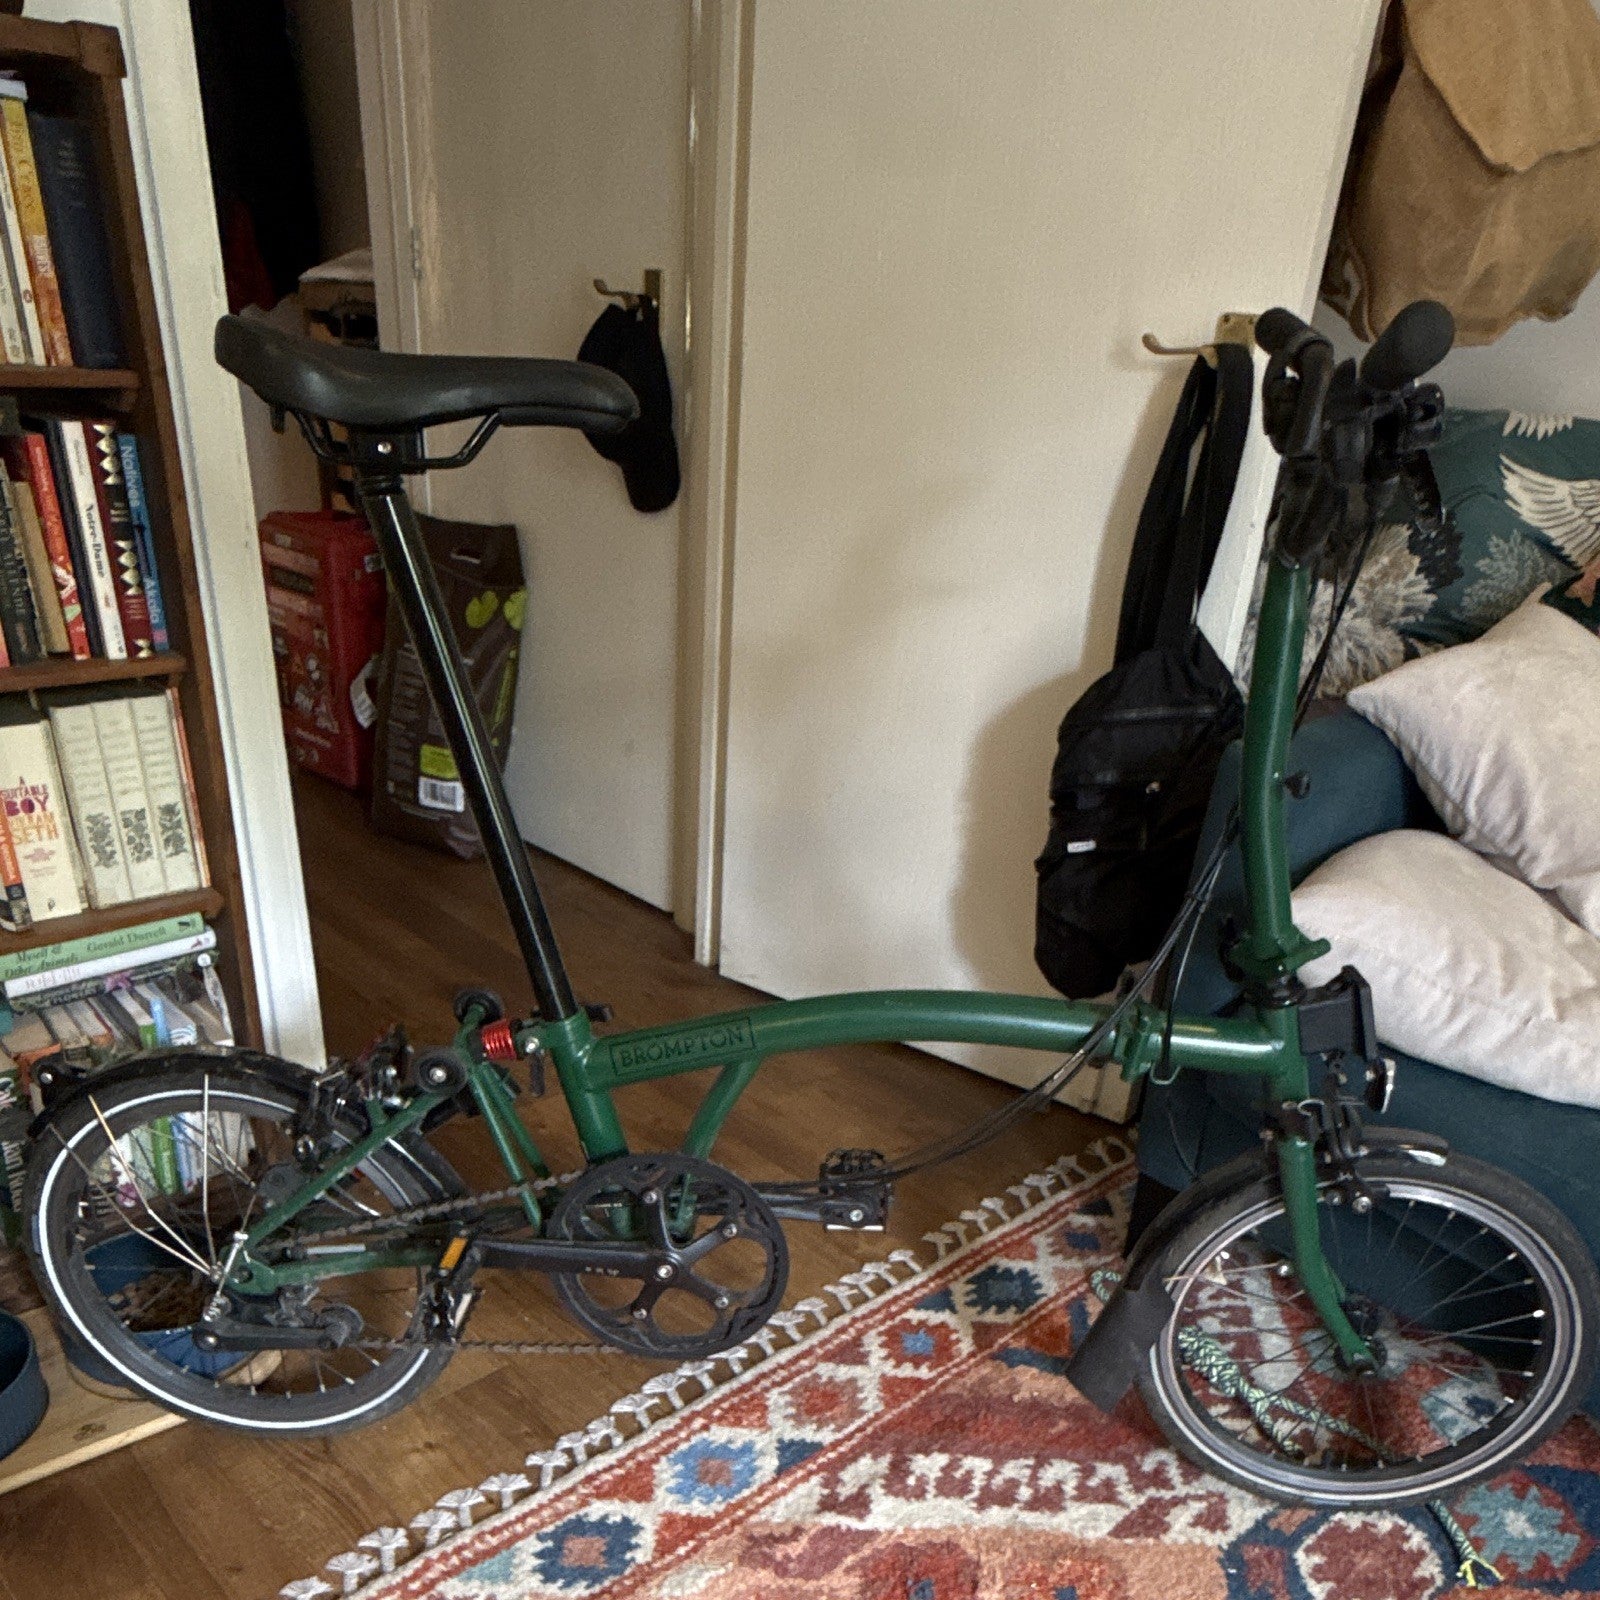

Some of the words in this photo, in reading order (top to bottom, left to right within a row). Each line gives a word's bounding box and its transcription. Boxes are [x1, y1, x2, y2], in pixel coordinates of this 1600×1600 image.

[121, 445, 140, 507] Natives
[85, 504, 105, 578] Notre-Dame
[143, 579, 160, 625] Akala
[1, 784, 49, 799] SUITABLE
[19, 775, 26, 787] A
[5, 793, 49, 816] BOY
[86, 937, 125, 953] Gerald
[127, 926, 166, 943] Durrell
[619, 1025, 744, 1068] BROMPTON
